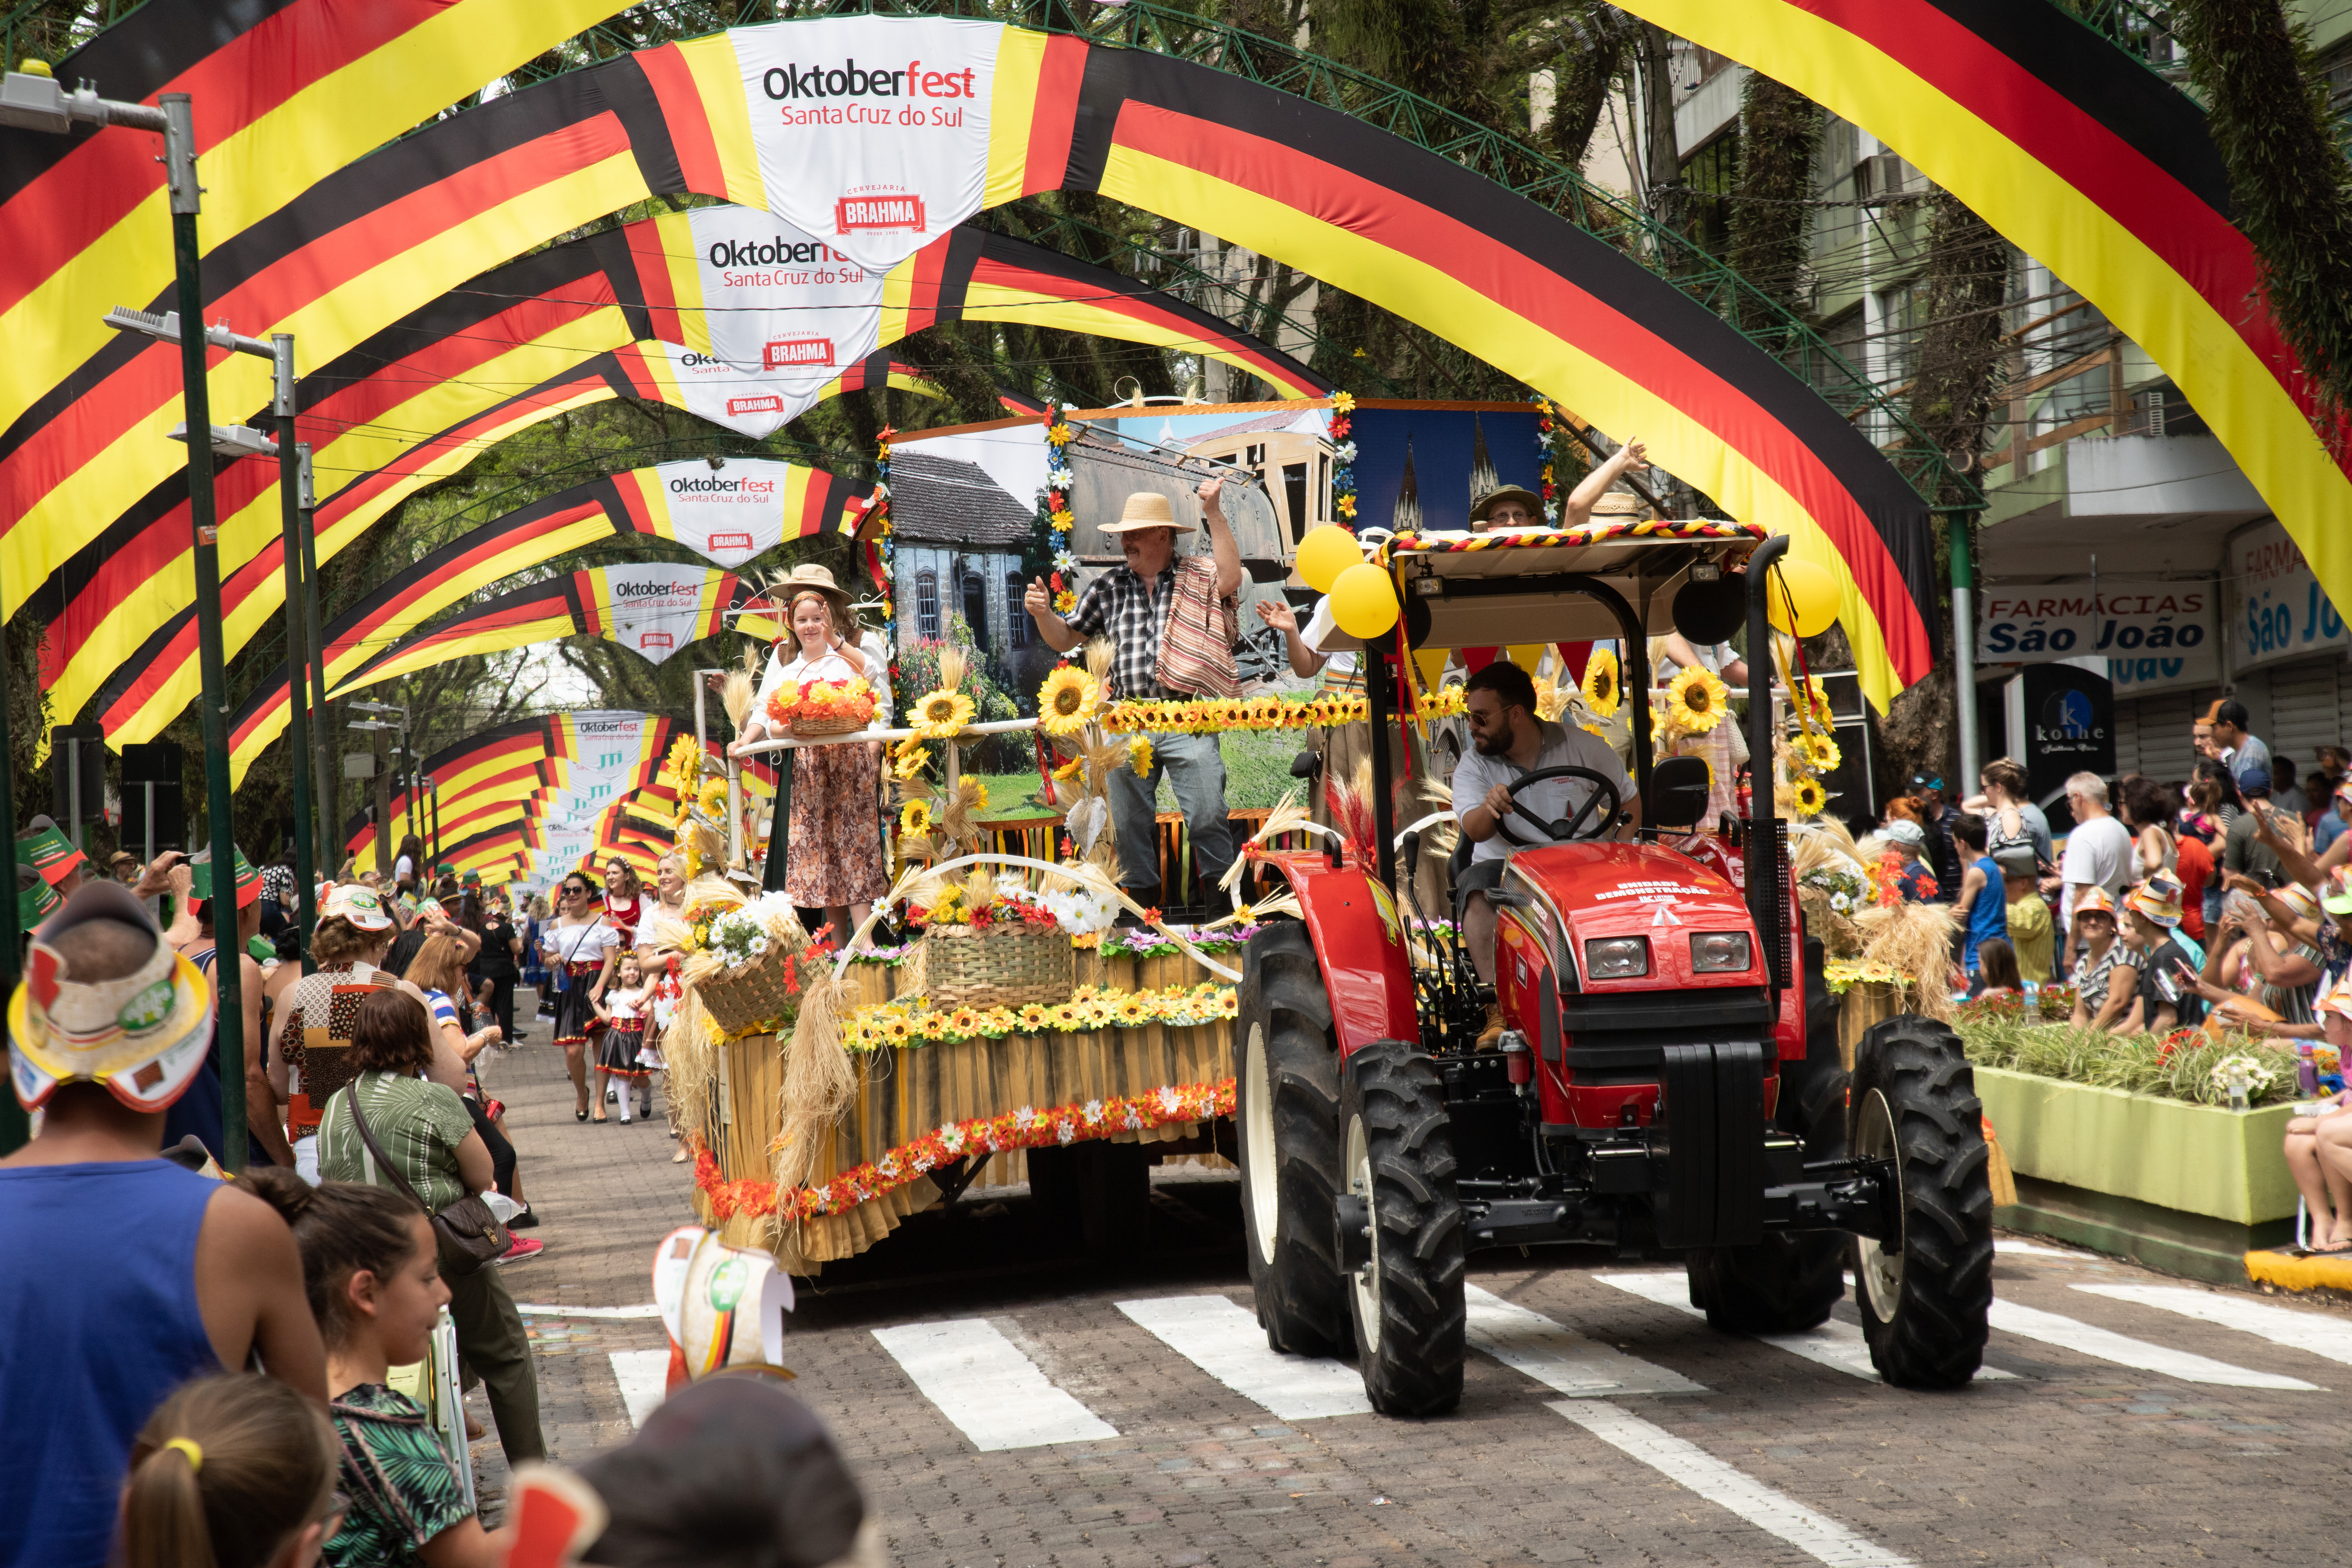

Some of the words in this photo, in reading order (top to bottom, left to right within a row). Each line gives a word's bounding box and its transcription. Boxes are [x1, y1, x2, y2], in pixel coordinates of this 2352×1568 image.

[764, 58, 975, 100] Oktoberfest
[782, 105, 842, 125] Santa
[847, 103, 891, 124] Cruz
[898, 104, 925, 126] do
[931, 106, 962, 127] Sul
[847, 184, 905, 194] CERVEJARIA
[845, 201, 916, 224] BRAHMA
[710, 236, 851, 268] Oktoberf
[724, 272, 771, 287] Santa
[774, 270, 809, 285] Cruz
[814, 268, 835, 284] do
[839, 268, 863, 283] Sul
[773, 331, 819, 340] CERVEJARIA
[771, 343, 827, 362] BRAHMA
[692, 366, 730, 374] Santa
[732, 398, 777, 411] BRAHMA
[670, 476, 775, 493] Oktoberfest
[678, 494, 709, 502] Santa
[711, 494, 733, 502] Cruz
[737, 494, 750, 503] do
[753, 495, 769, 503] Sul
[713, 536, 748, 547] BRAHMA
[616, 580, 697, 596] Oktoberfest
[623, 599, 647, 608] Santa
[648, 599, 665, 607] Cruz
[667, 598, 677, 607] do
[1989, 594, 2203, 619] FARMÁCIAS
[2248, 588, 2291, 656] São
[2302, 581, 2343, 643] Jo
[644, 635, 670, 645] BRAHMA
[1986, 620, 2077, 653] São
[2092, 616, 2205, 650] João
[2060, 700, 2079, 725] k
[580, 720, 638, 732] Oktoberfest
[2035, 724, 2104, 741] kothe
[1595, 885, 1710, 900] DEMONSTRAÇÃO
[1532, 898, 1548, 923] AGRITECH
